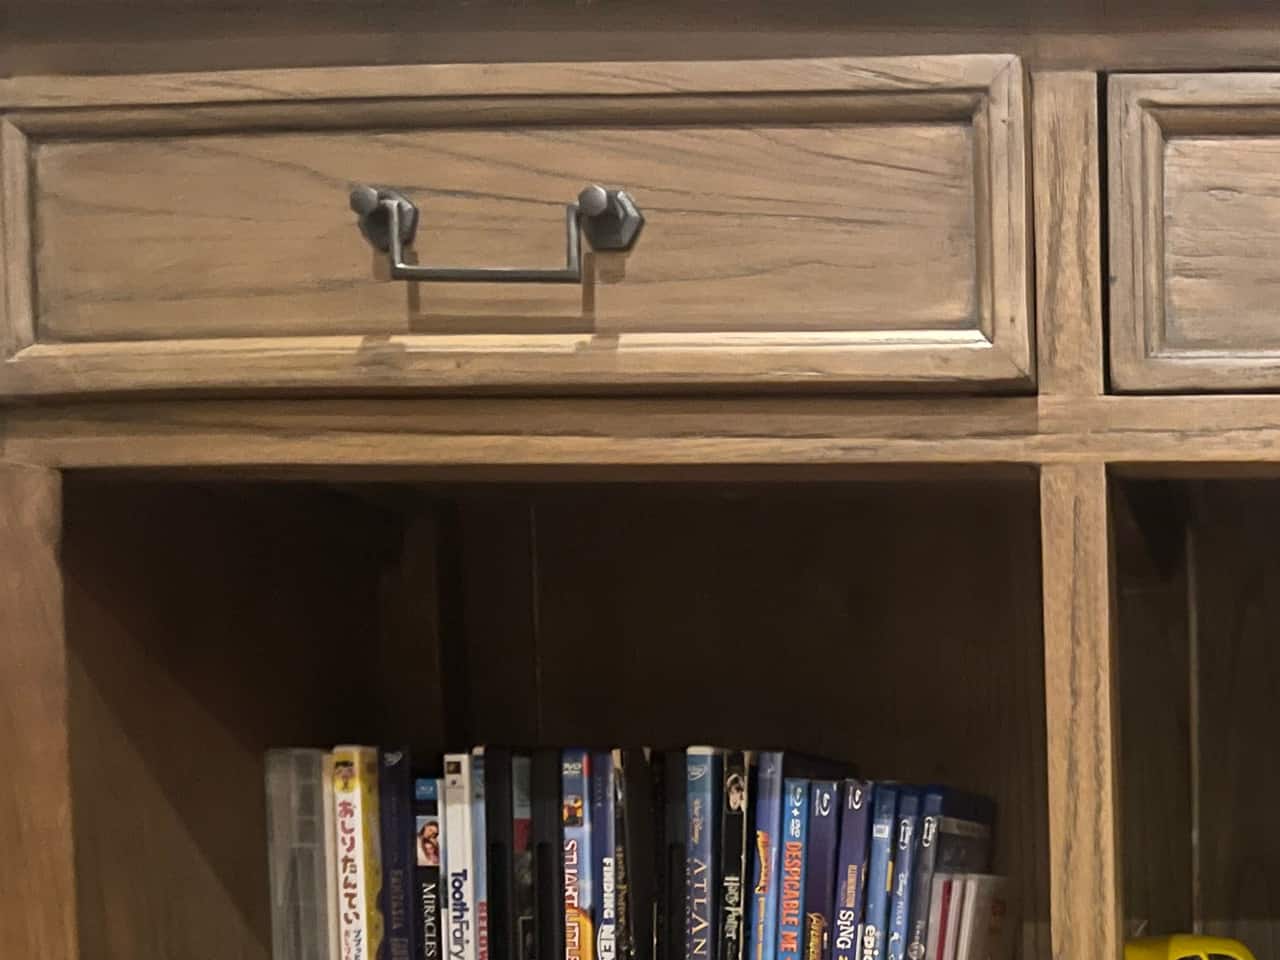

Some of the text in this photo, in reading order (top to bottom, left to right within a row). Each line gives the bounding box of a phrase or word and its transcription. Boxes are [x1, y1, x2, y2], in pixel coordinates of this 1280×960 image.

[563, 839, 580, 907] STUART
[602, 857, 616, 919] FINDING
[782, 841, 803, 926] DESPICABLE
[422, 883, 438, 957] MIRACLES
[780, 931, 798, 953] ME
[834, 909, 855, 950] SING
